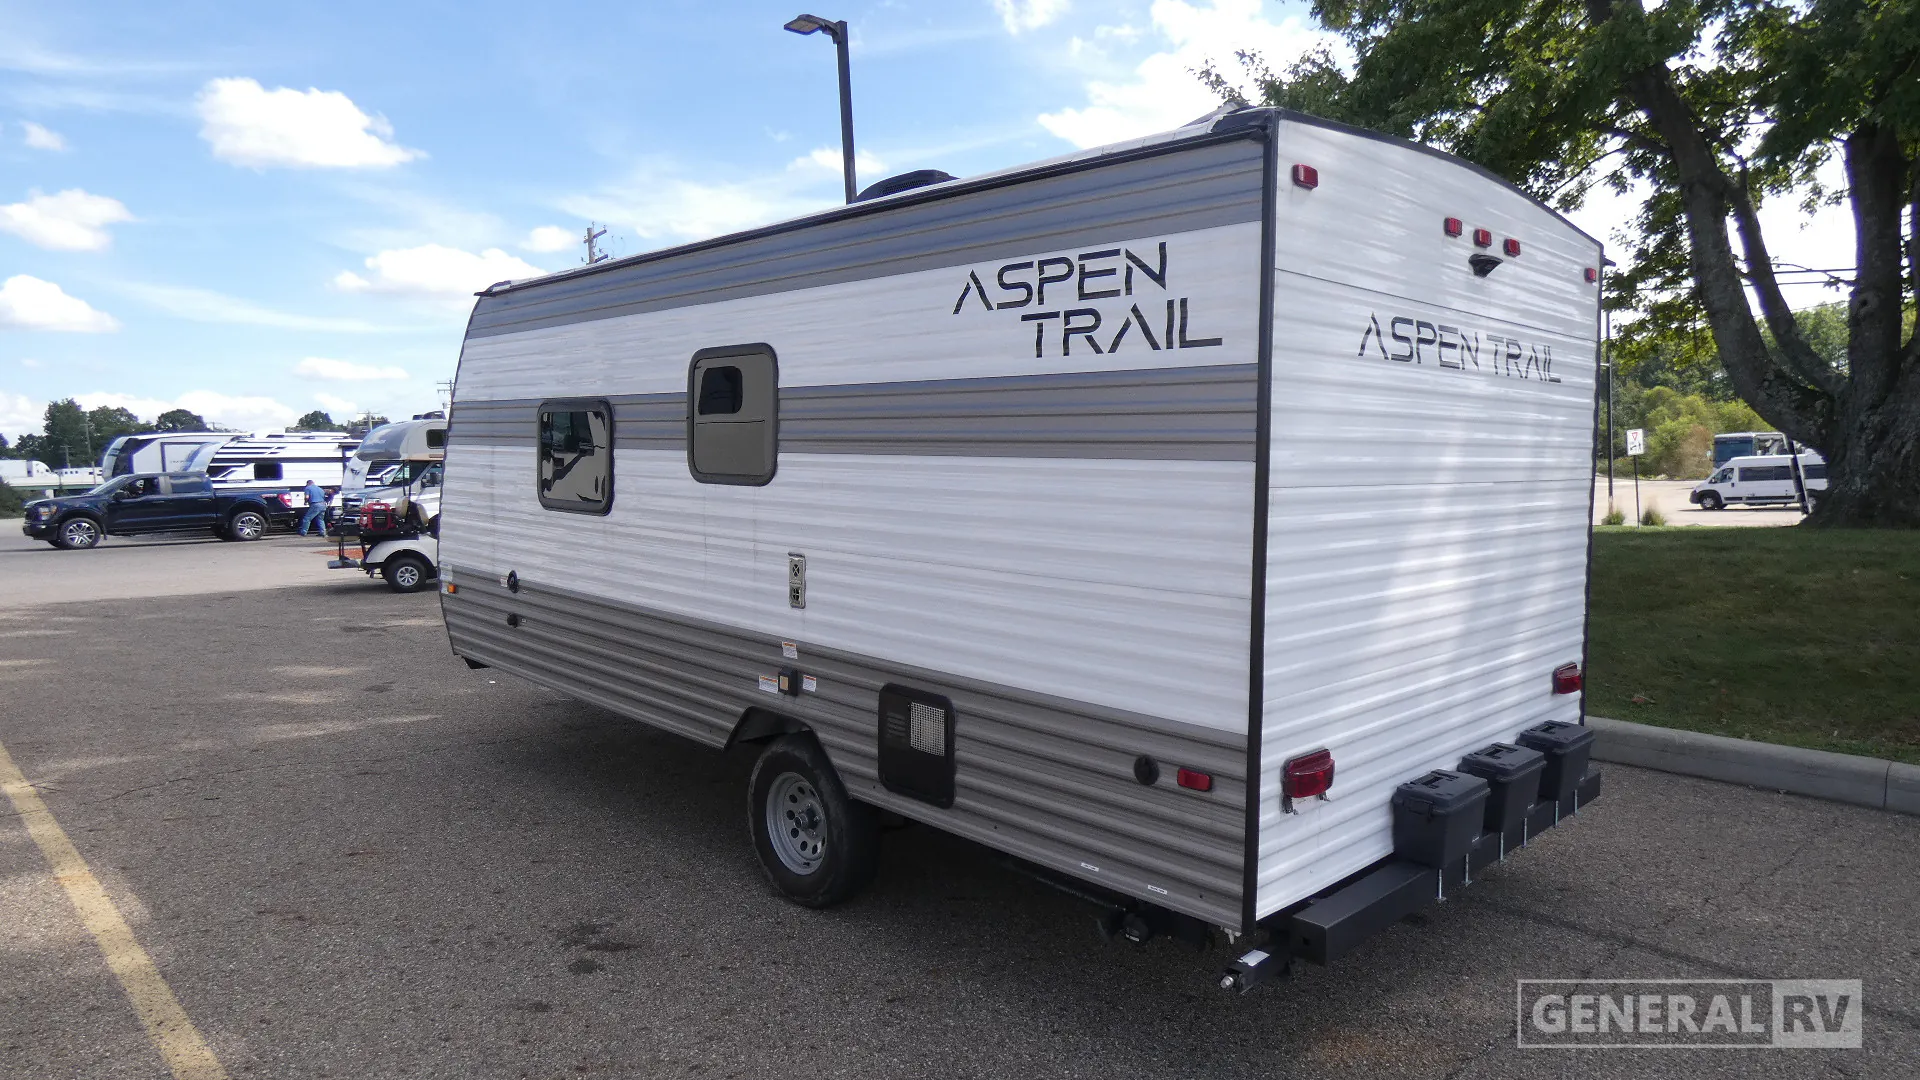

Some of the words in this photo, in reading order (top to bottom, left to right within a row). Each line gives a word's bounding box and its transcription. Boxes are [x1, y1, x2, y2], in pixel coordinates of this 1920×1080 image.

[953, 242, 1167, 314] ASPEN
[1021, 298, 1223, 358] TRAIL
[1358, 311, 1480, 371] ASPEN
[1486, 334, 1561, 383] TRAIL
